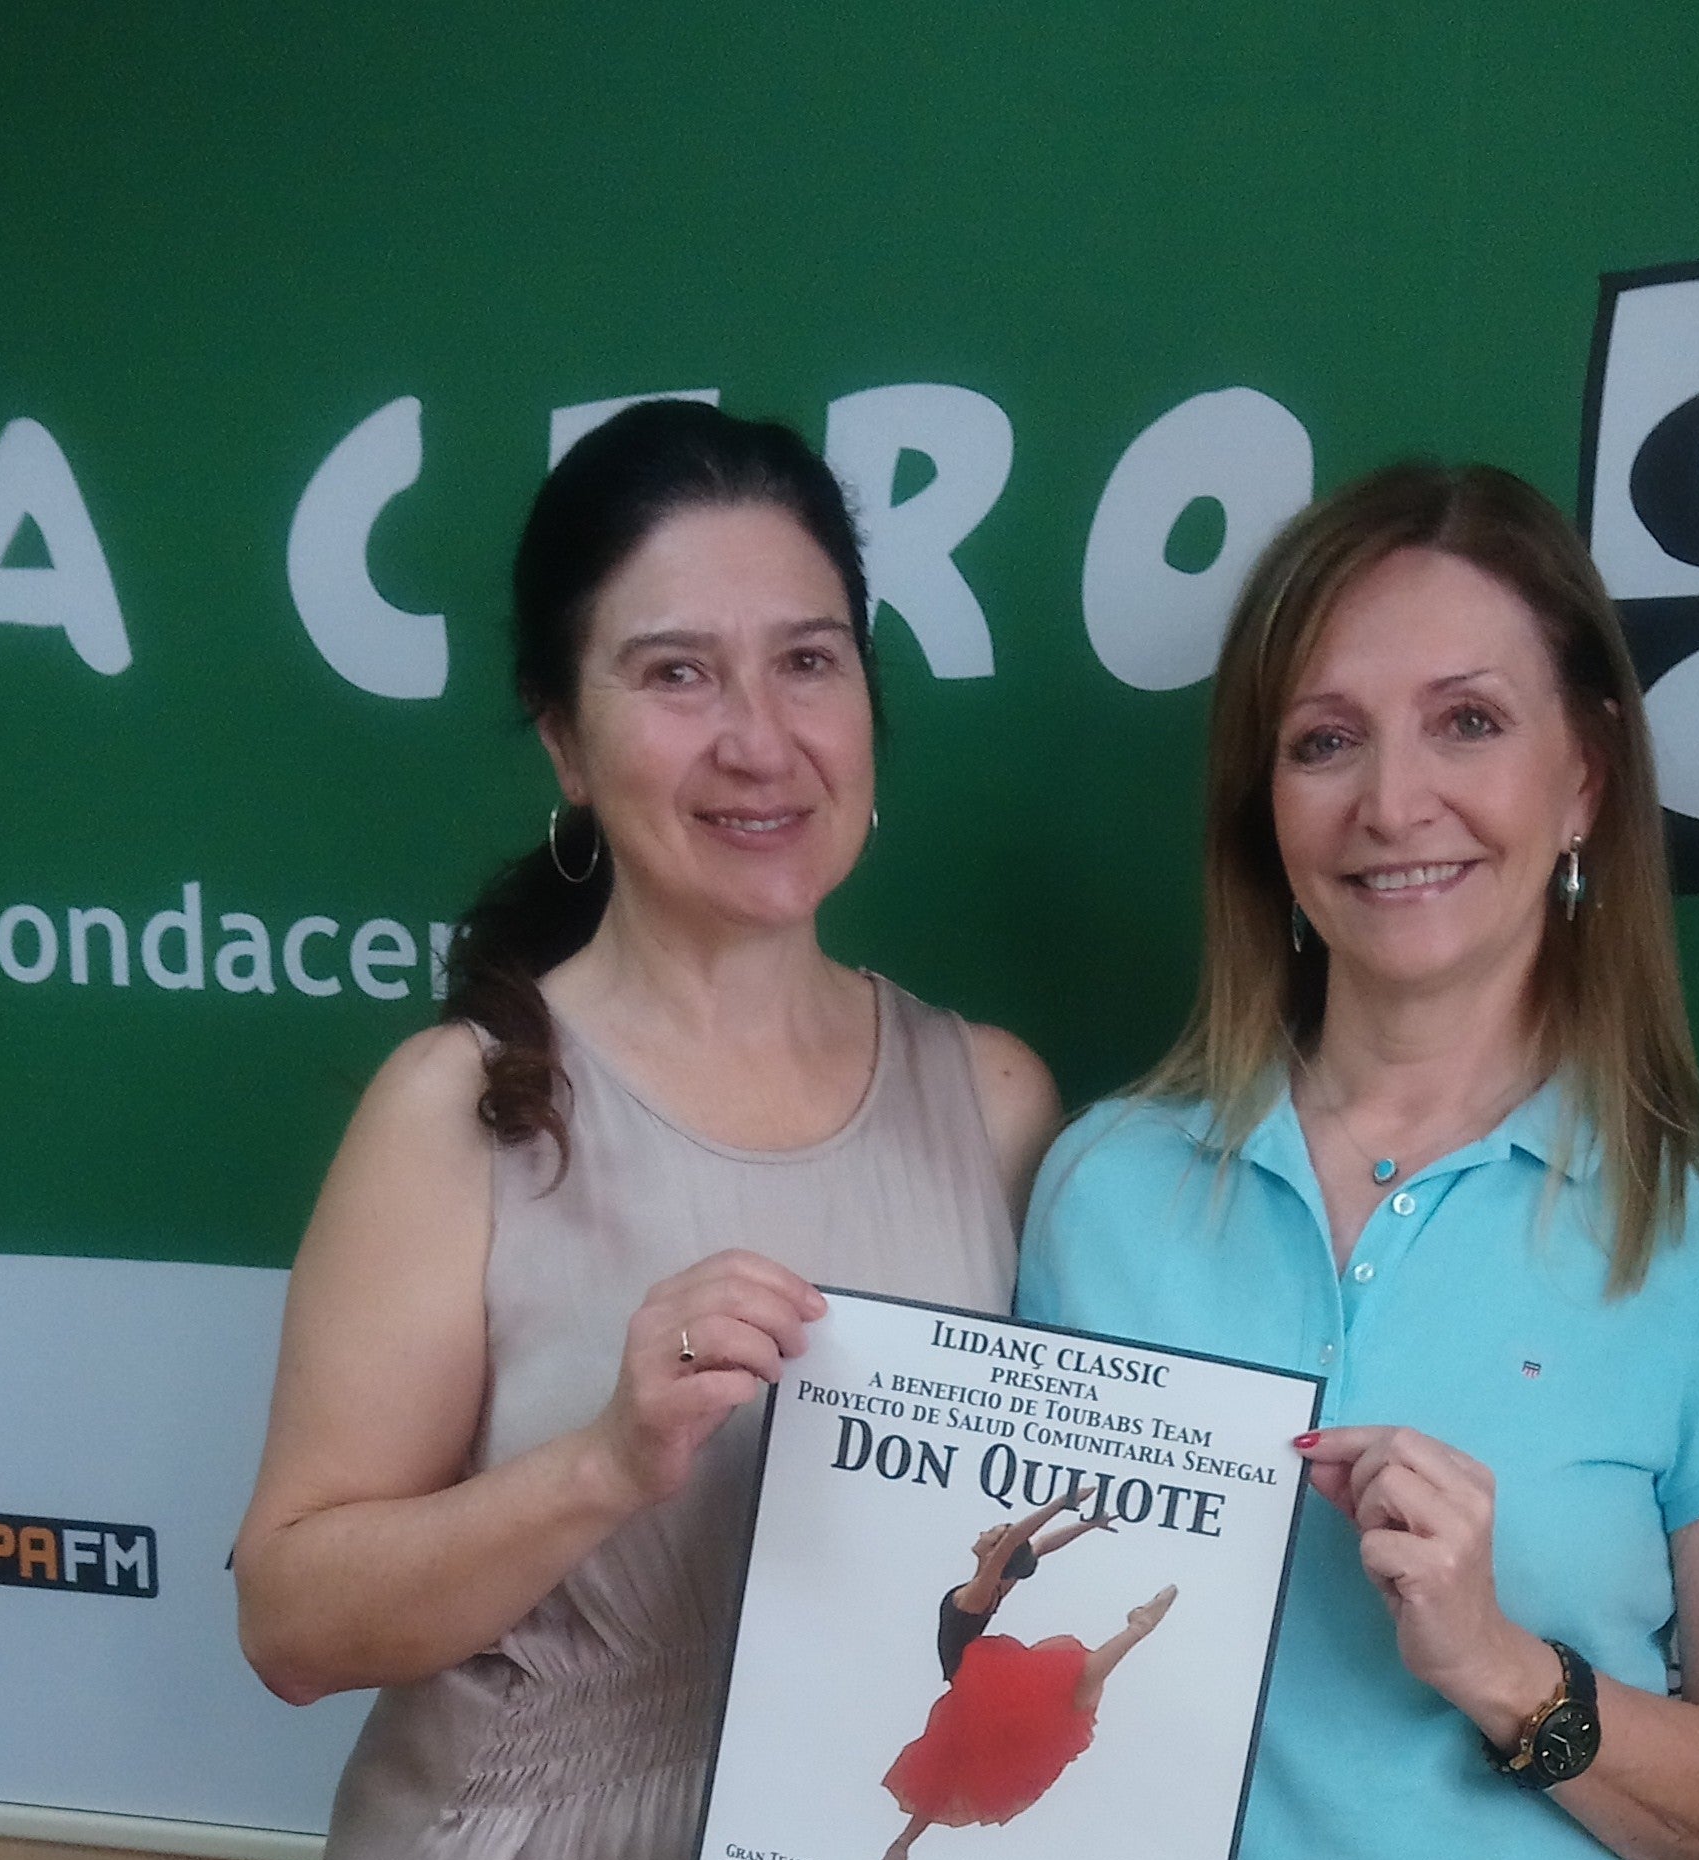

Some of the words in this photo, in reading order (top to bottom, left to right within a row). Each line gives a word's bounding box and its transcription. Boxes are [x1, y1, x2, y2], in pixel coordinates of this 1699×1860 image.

[287, 384, 1314, 700] CRO
[868, 1371, 884, 1388] A
[890, 1374, 1002, 1410] BENEFICIO
[1009, 1396, 1039, 1417] DE
[1045, 1399, 1144, 1436] TOUBABS
[1152, 1418, 1214, 1448] TEAM
[990, 1366, 1100, 1401] PRESENTA
[1057, 1348, 1170, 1388] CLASSIC
[797, 1380, 905, 1418] PROYECTO
[911, 1404, 941, 1425] DE
[946, 1407, 1015, 1438] SALUD
[1023, 1420, 1175, 1468] COMUNITARIA
[1182, 1450, 1278, 1486] SENEGAL
[830, 1414, 960, 1490] DON
[979, 1442, 1227, 1538] QUIJOTE
